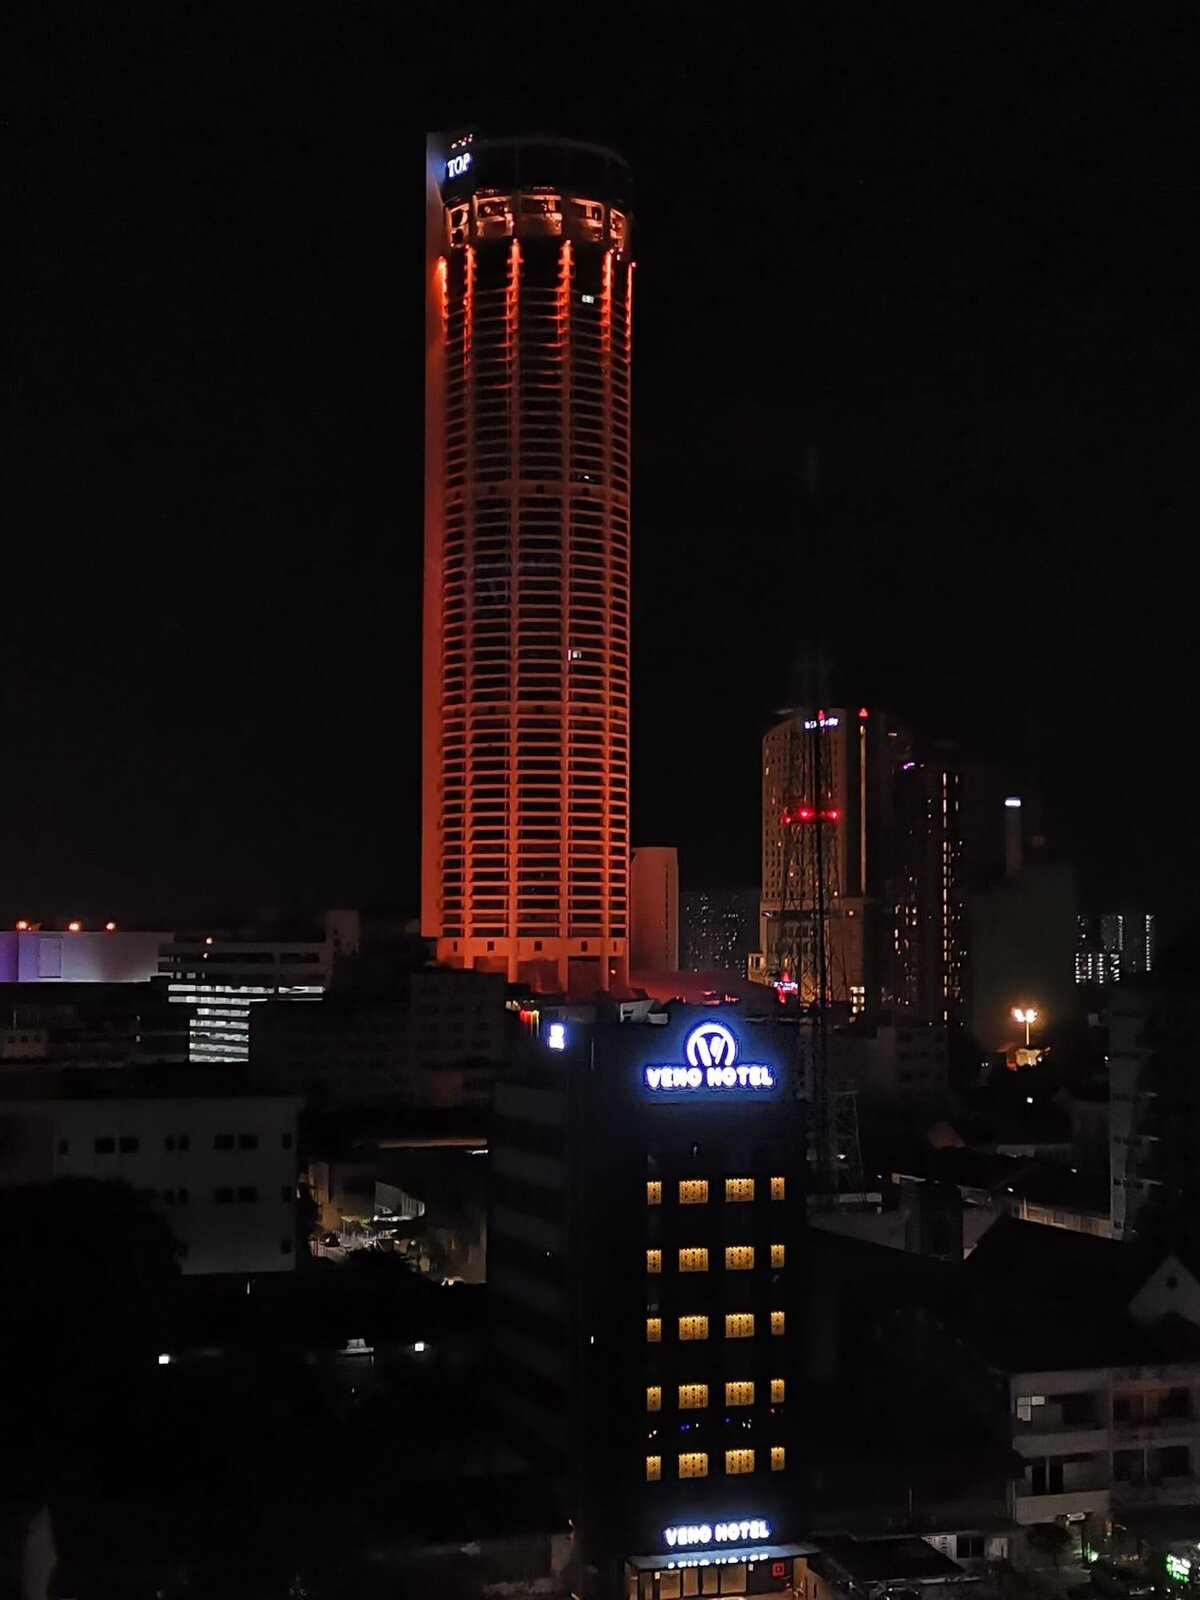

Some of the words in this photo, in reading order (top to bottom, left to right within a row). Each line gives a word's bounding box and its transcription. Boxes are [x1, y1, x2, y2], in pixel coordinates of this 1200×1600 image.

[447, 152, 471, 178] TOP
[646, 1066, 702, 1088] VENO
[706, 1065, 773, 1087] HOTEL
[664, 1524, 712, 1546] VENO
[714, 1519, 770, 1542] HOTEL
